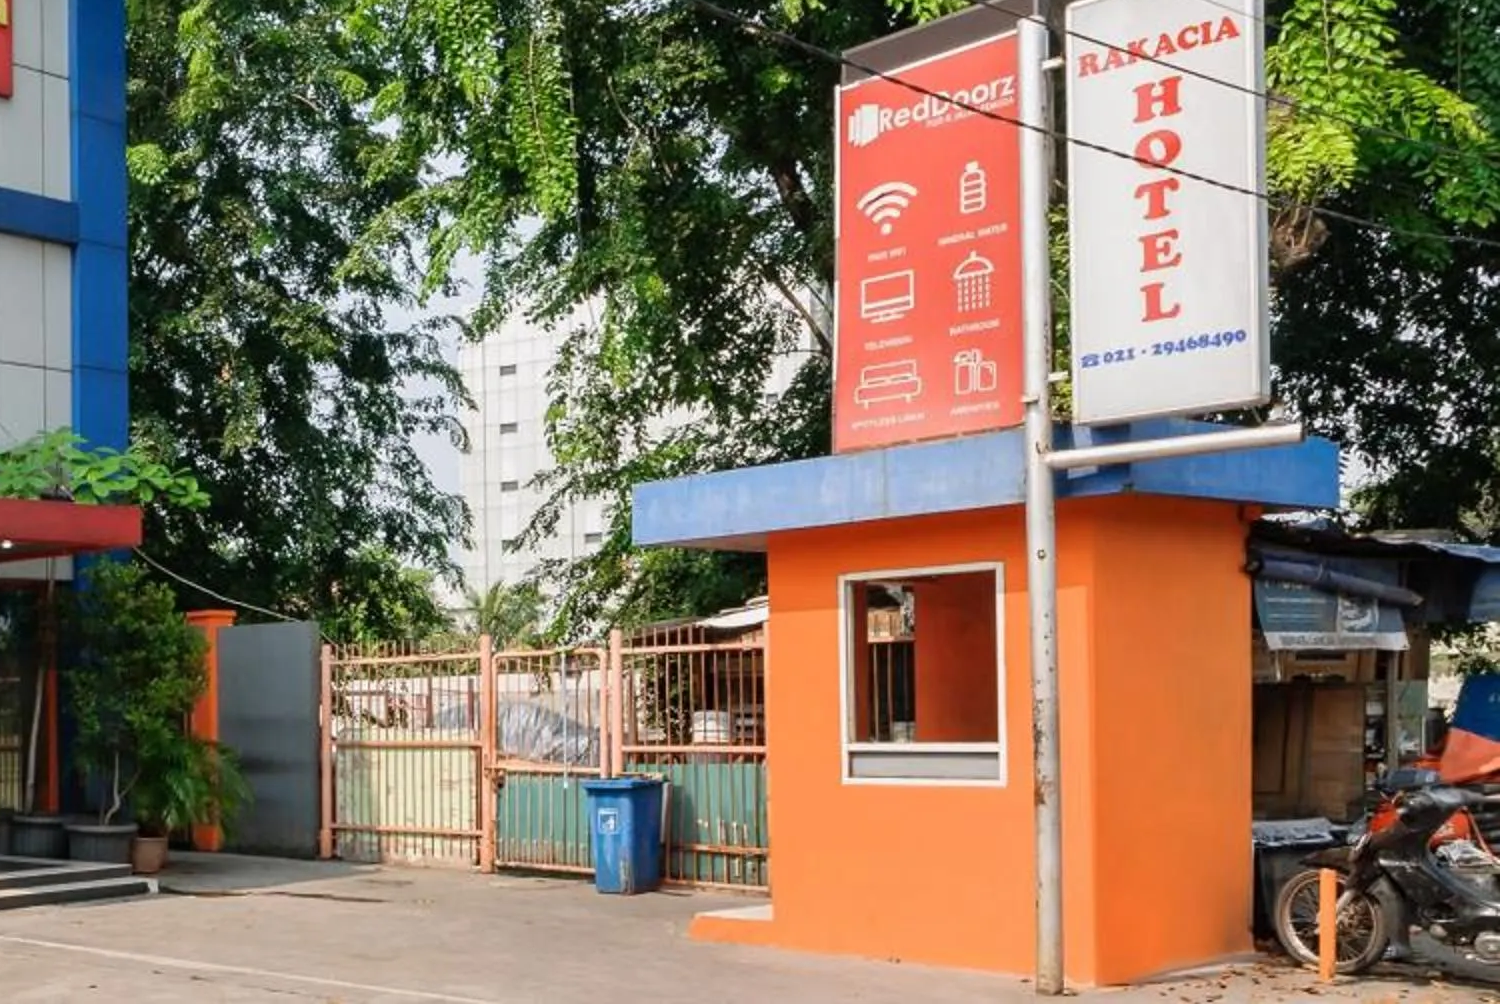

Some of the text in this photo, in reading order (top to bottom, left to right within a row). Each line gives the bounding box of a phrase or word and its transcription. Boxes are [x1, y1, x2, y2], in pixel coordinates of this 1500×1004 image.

[1078, 16, 1240, 78] RAKACIA
[879, 75, 1015, 133] RedDoorz
[1132, 75, 1183, 323] HOTEL
[1103, 347, 1136, 365] 021
[1151, 328, 1248, 357] 29468490
